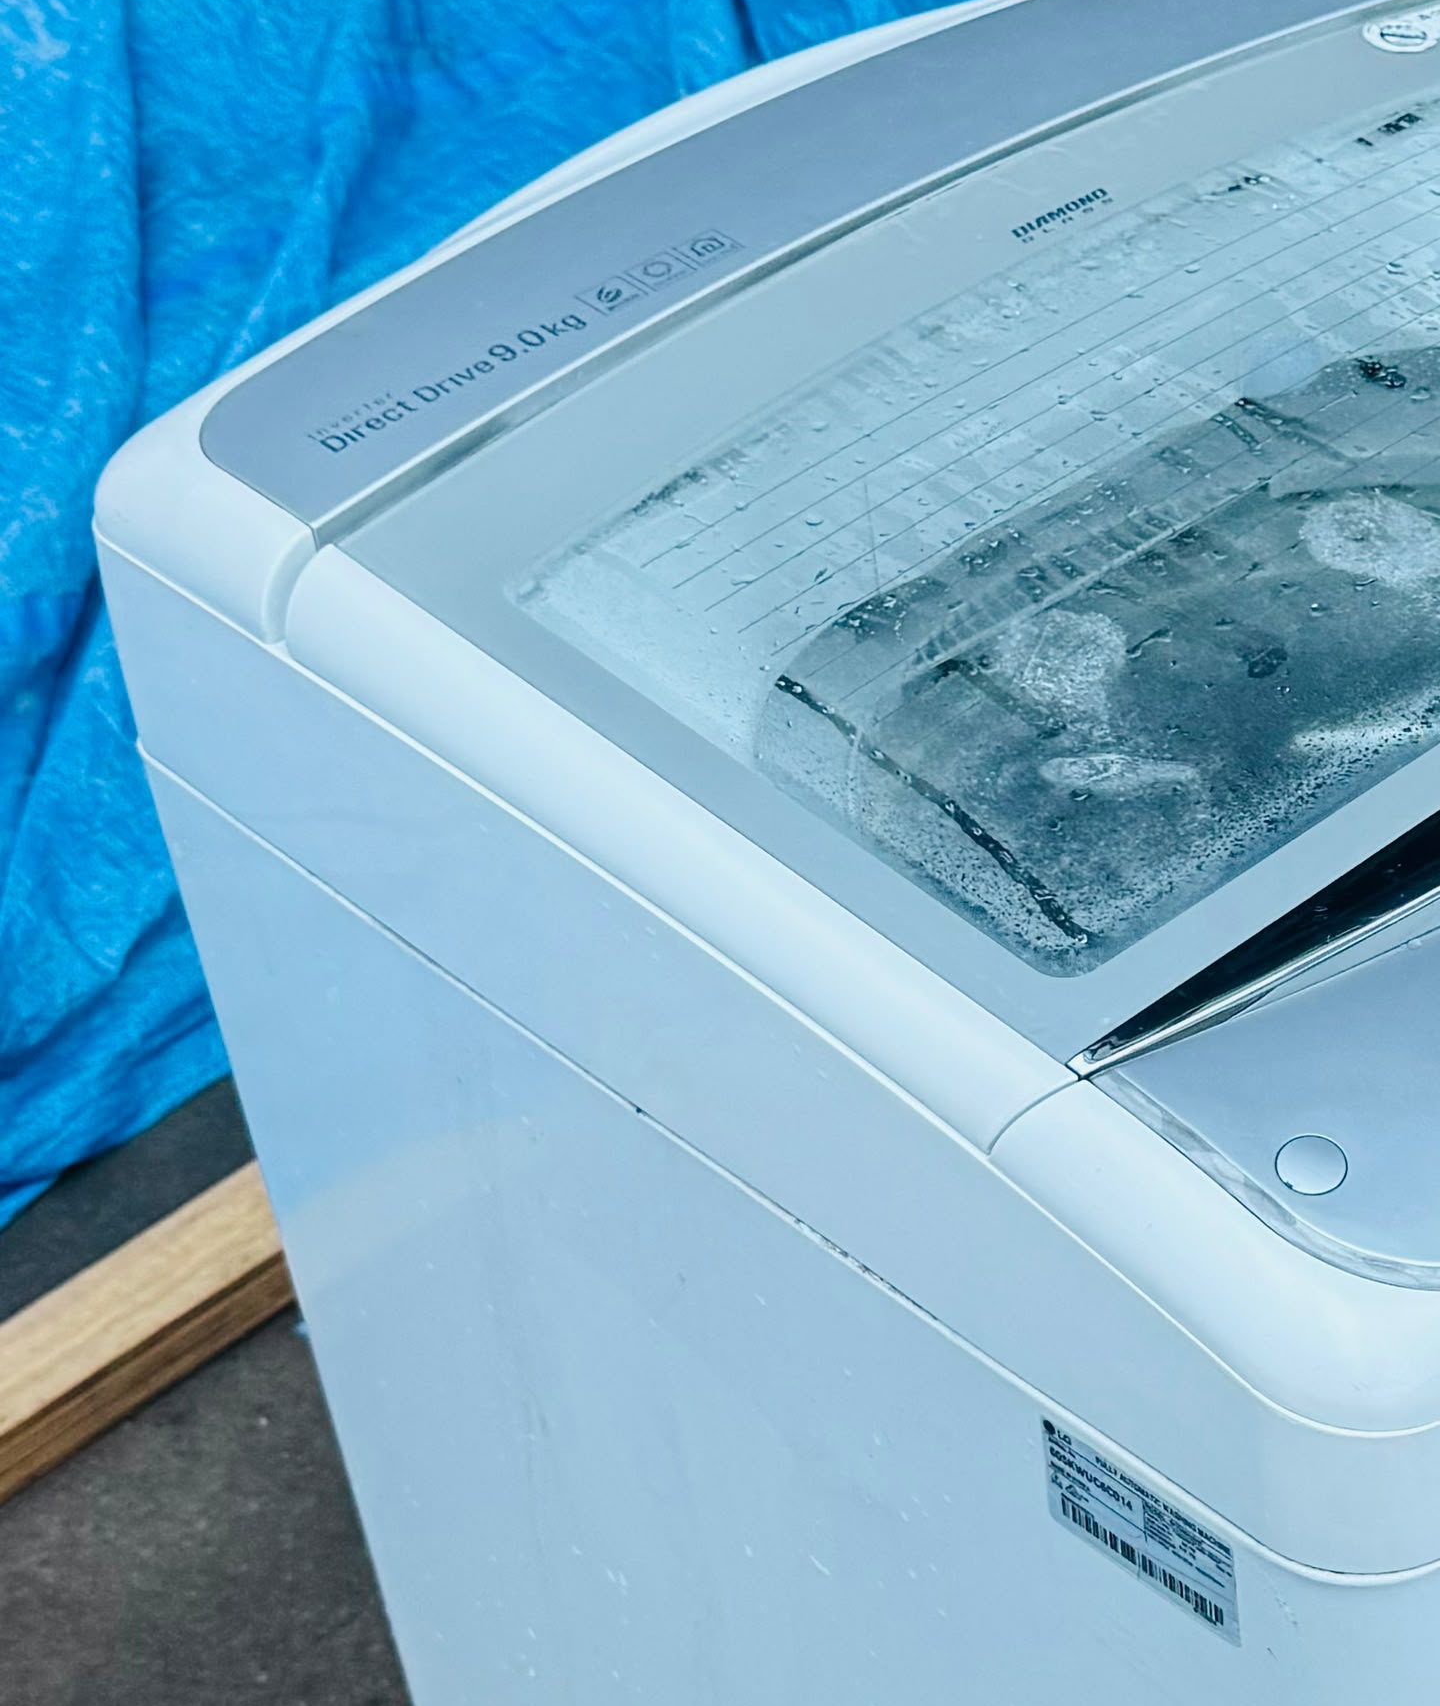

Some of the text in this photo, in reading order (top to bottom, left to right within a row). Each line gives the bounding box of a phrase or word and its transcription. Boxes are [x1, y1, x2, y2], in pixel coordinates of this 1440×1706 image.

[1011, 188, 1108, 238] DIAMOND
[319, 398, 418, 454] Direct
[412, 356, 496, 404] Drive
